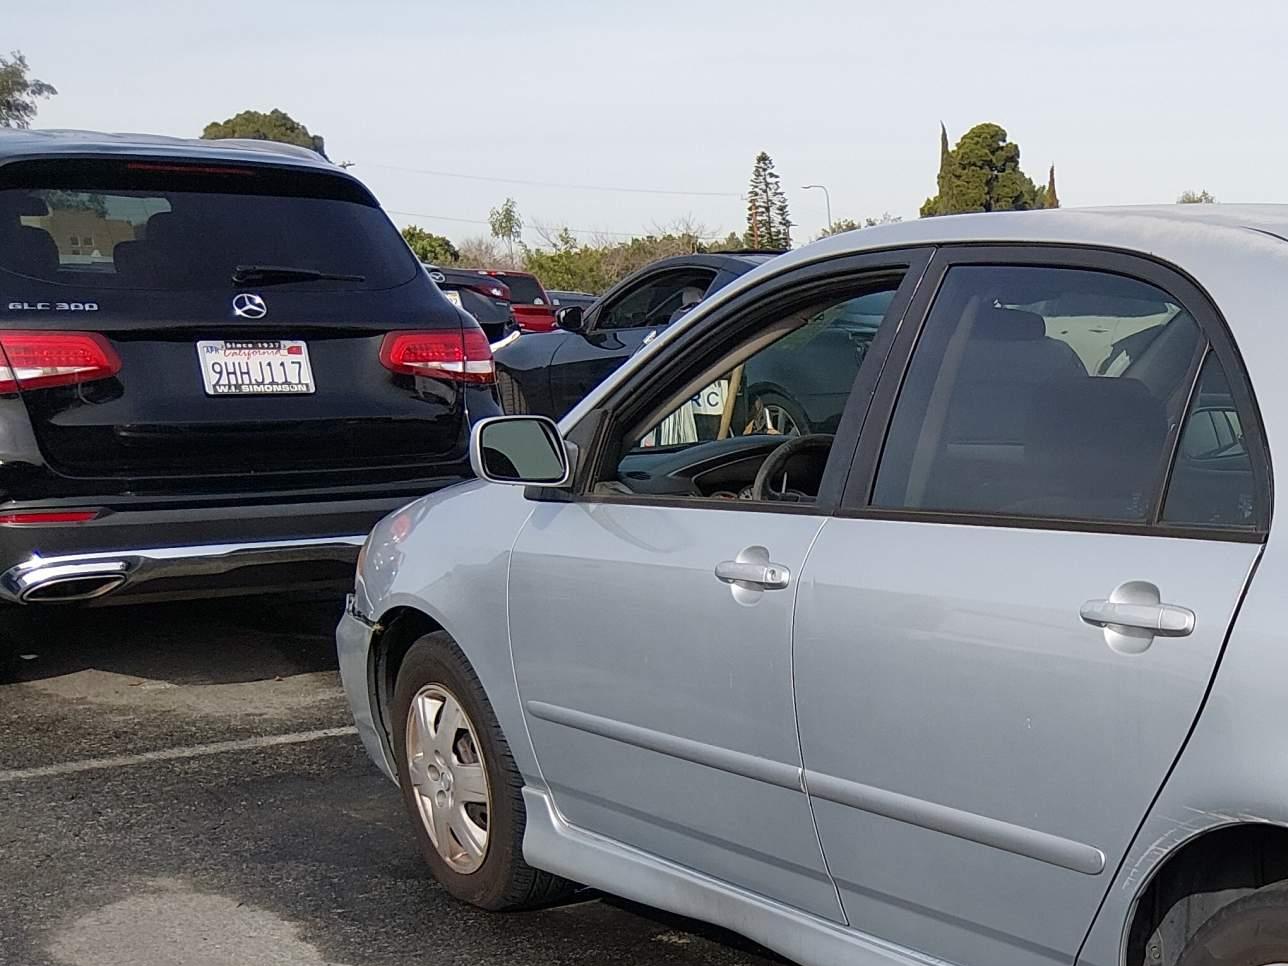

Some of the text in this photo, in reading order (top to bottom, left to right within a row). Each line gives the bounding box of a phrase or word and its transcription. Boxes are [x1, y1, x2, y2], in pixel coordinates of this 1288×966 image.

[8, 302, 98, 311] GLC 300
[211, 361, 302, 385] 9HHJ117
[215, 384, 307, 393] W.I. SIMONSON
